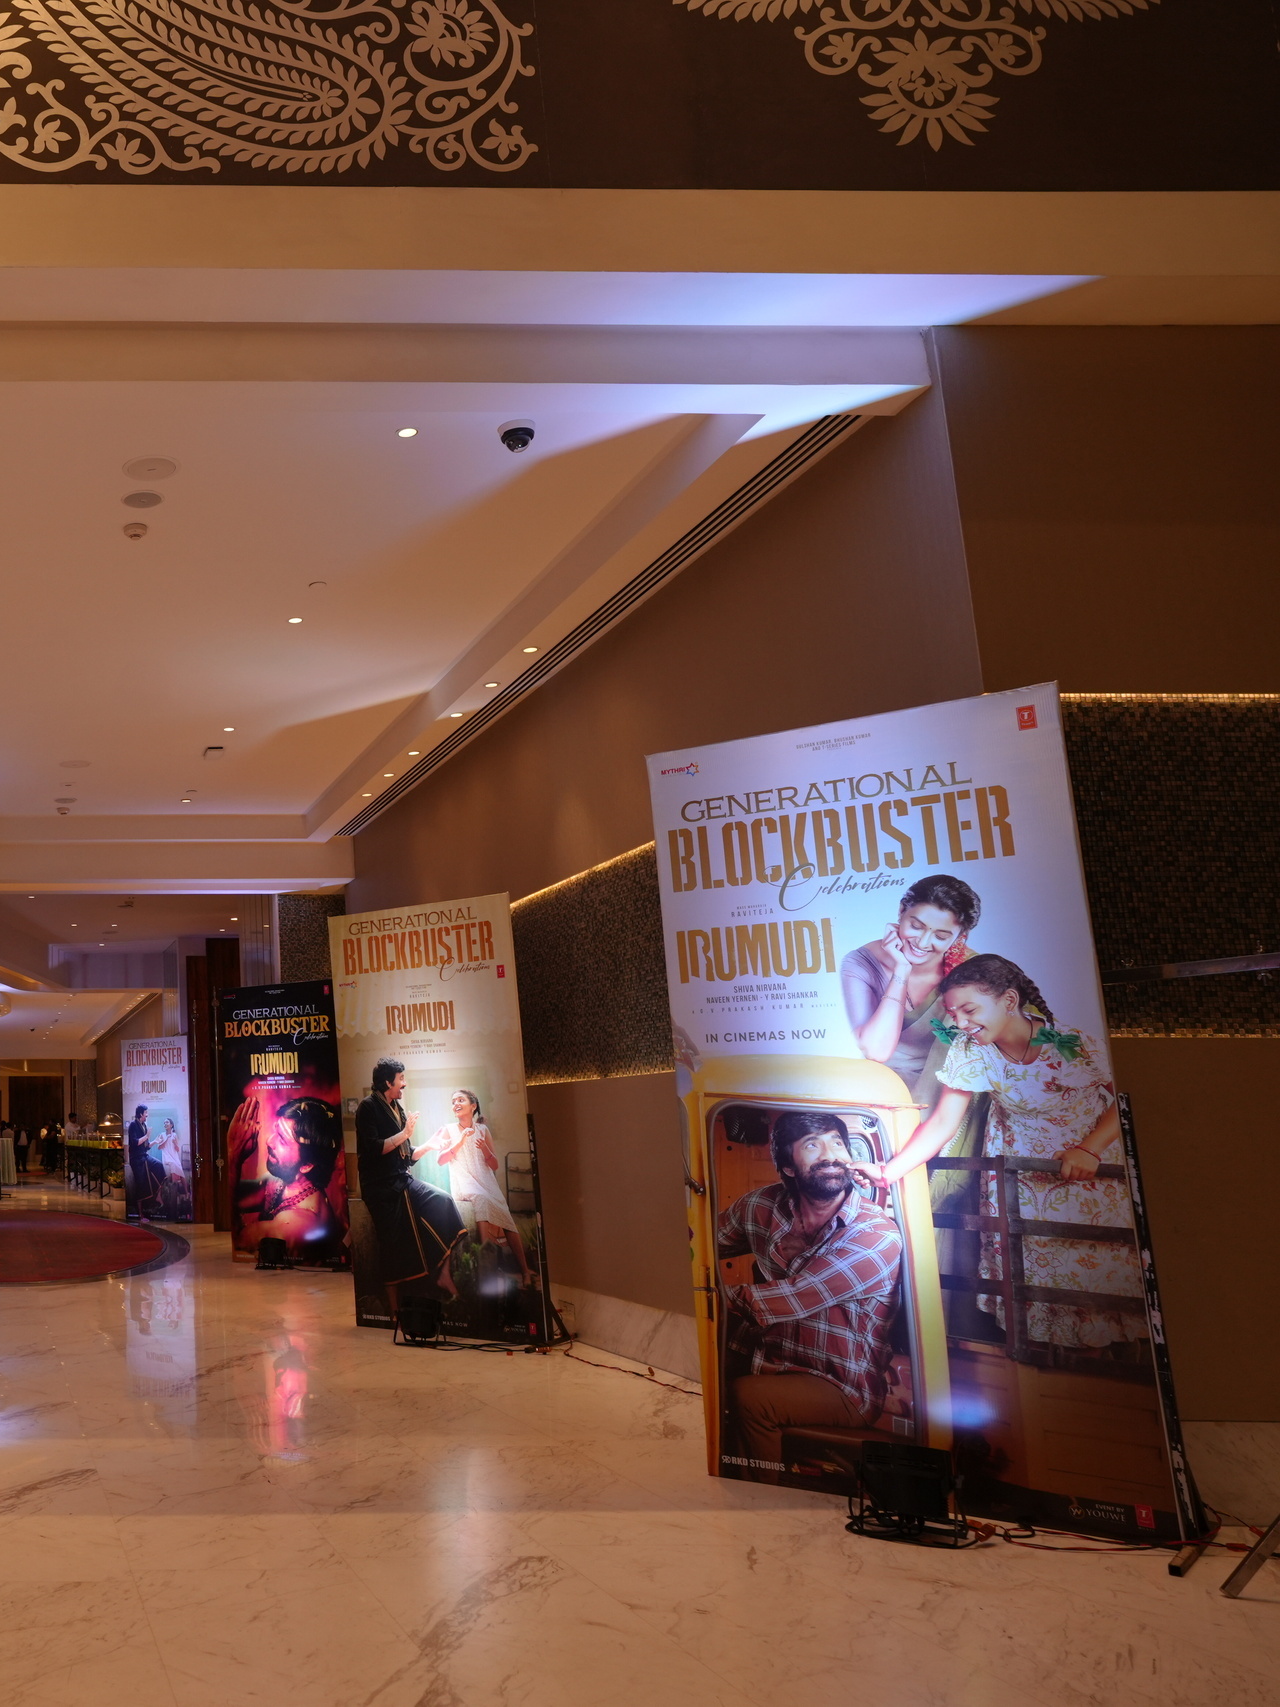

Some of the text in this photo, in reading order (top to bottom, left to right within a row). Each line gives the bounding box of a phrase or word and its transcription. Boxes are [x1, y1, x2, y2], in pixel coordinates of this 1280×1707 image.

[661, 766, 686, 775] MYTHRI
[680, 761, 973, 822] GENERATIONAL
[668, 785, 1015, 893] BLOCKBUSTER
[763, 862, 907, 911] Celebrations
[349, 906, 477, 935] GENERATIONAL
[731, 908, 774, 918] RAVITEJA
[343, 920, 495, 976] BLOCKBUSTER
[676, 917, 837, 984] IRUMUDI
[706, 995, 731, 1004] NAVEEN
[731, 994, 759, 1003] YERNENI
[771, 993, 786, 1001] RAVI
[787, 990, 818, 1000] SHANKAR
[733, 982, 787, 994] SHIVA NIRVANA
[232, 1004, 319, 1020] GENERATIONAL
[772, 1002, 804, 1010] KUMAR
[224, 1015, 330, 1038] BLOCKBUSTER
[385, 1000, 456, 1035] IRUMUDI
[128, 1041, 176, 1050] GENERATIONAL
[705, 1029, 826, 1043] IN CINEMAS NOW
[126, 1047, 182, 1067] BLOCKBUSTER
[250, 1051, 298, 1076] IRUMUDI
[732, 1456, 748, 1466] RKD
[750, 1459, 786, 1472] STUDIOS
